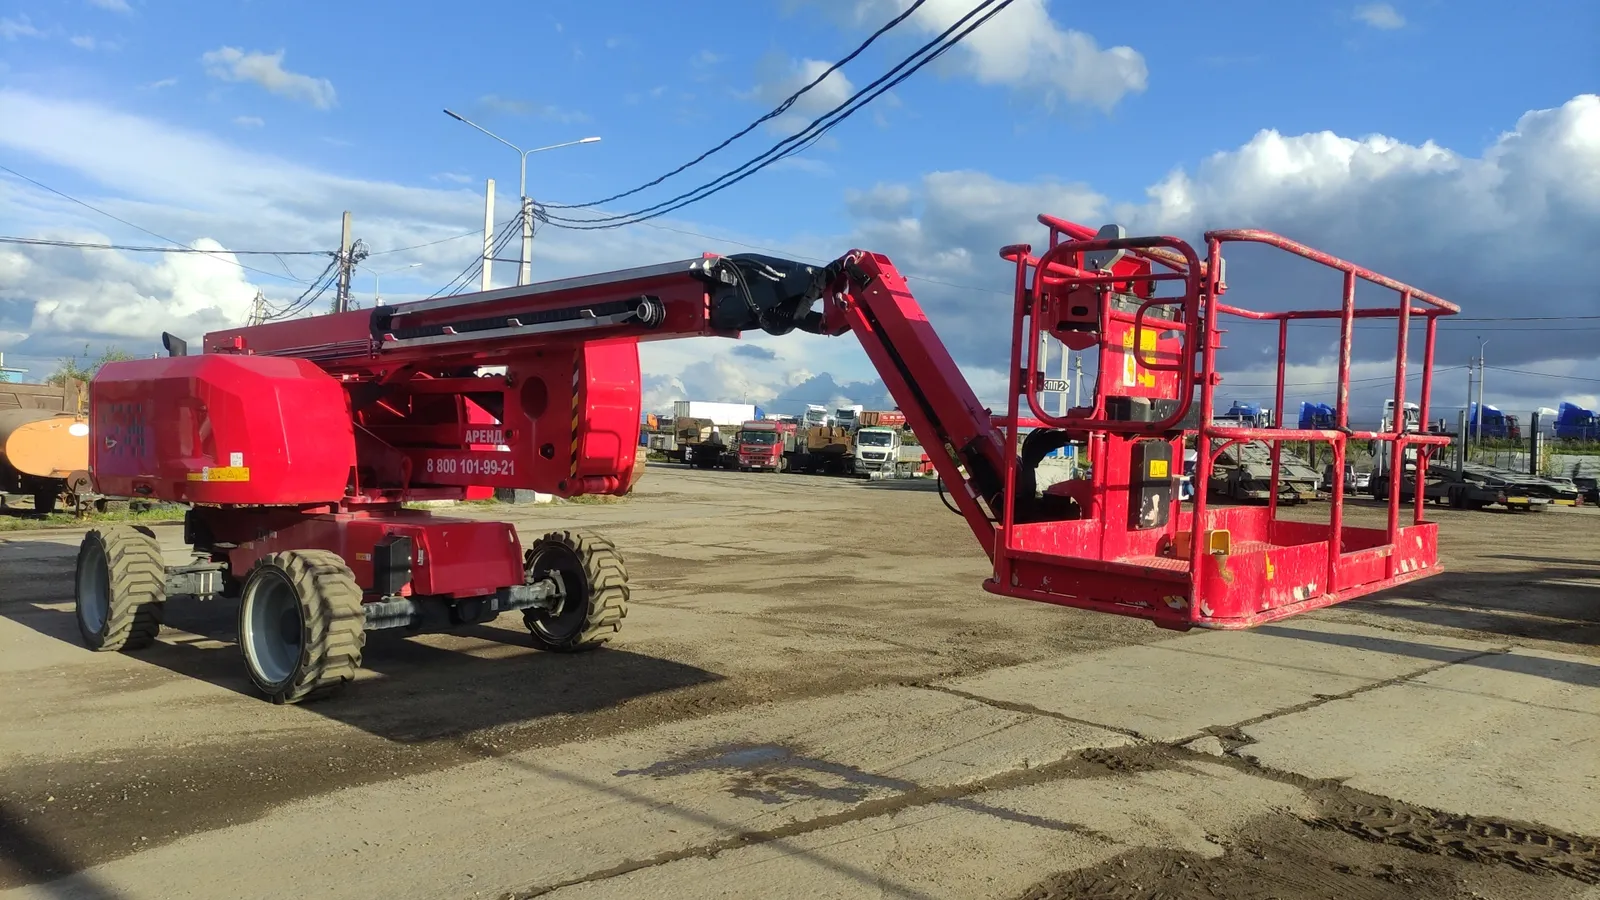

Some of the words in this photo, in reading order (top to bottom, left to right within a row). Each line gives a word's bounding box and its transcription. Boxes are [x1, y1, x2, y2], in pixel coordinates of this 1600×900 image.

[465, 429, 506, 444] АРЕНД
[427, 458, 433, 473] 8
[437, 458, 457, 474] 800
[460, 459, 515, 476] 101-99-21
